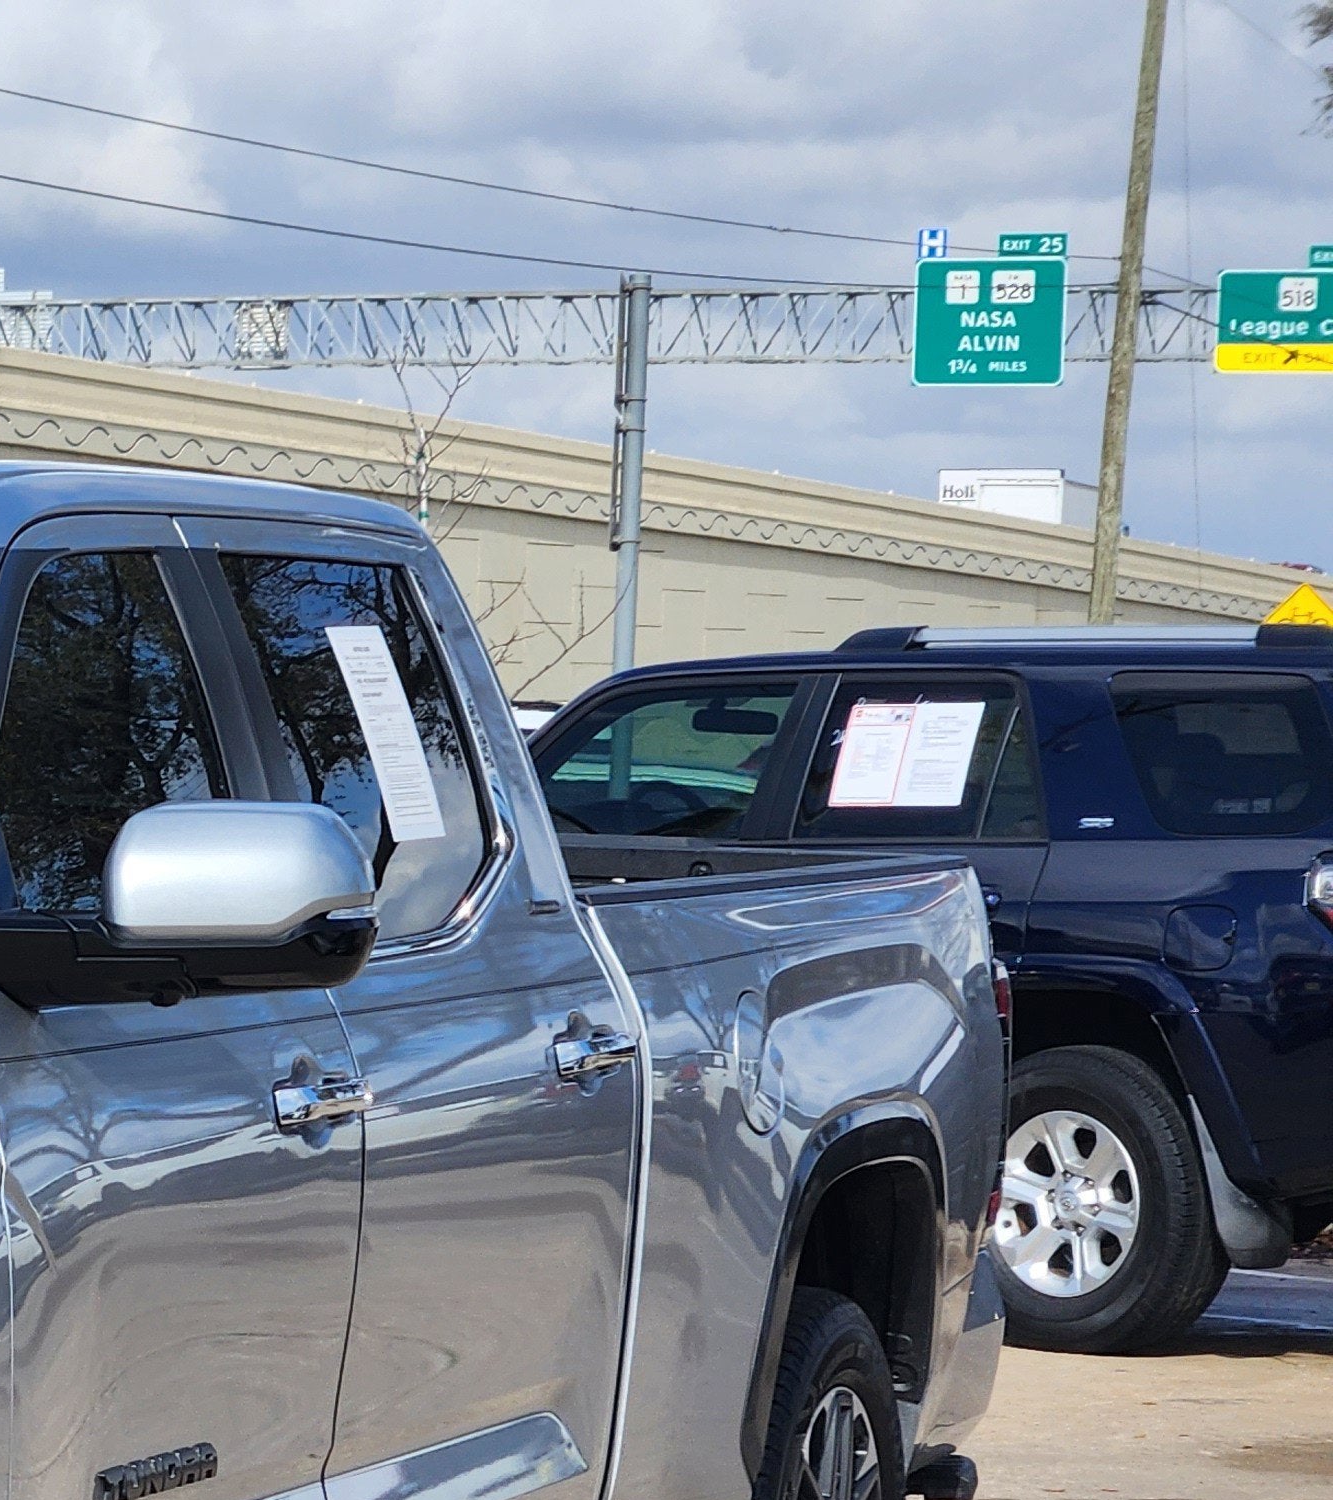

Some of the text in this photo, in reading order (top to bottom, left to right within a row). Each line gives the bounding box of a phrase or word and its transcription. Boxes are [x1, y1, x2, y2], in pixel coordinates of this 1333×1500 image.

[1002, 237, 1064, 253] EXIT 25
[960, 284, 966, 300] 1
[996, 283, 1031, 300] 528
[1282, 290, 1315, 307] 518
[960, 311, 1017, 328] NASA
[957, 335, 1020, 352] ALVIN
[988, 361, 1027, 372] MILES
